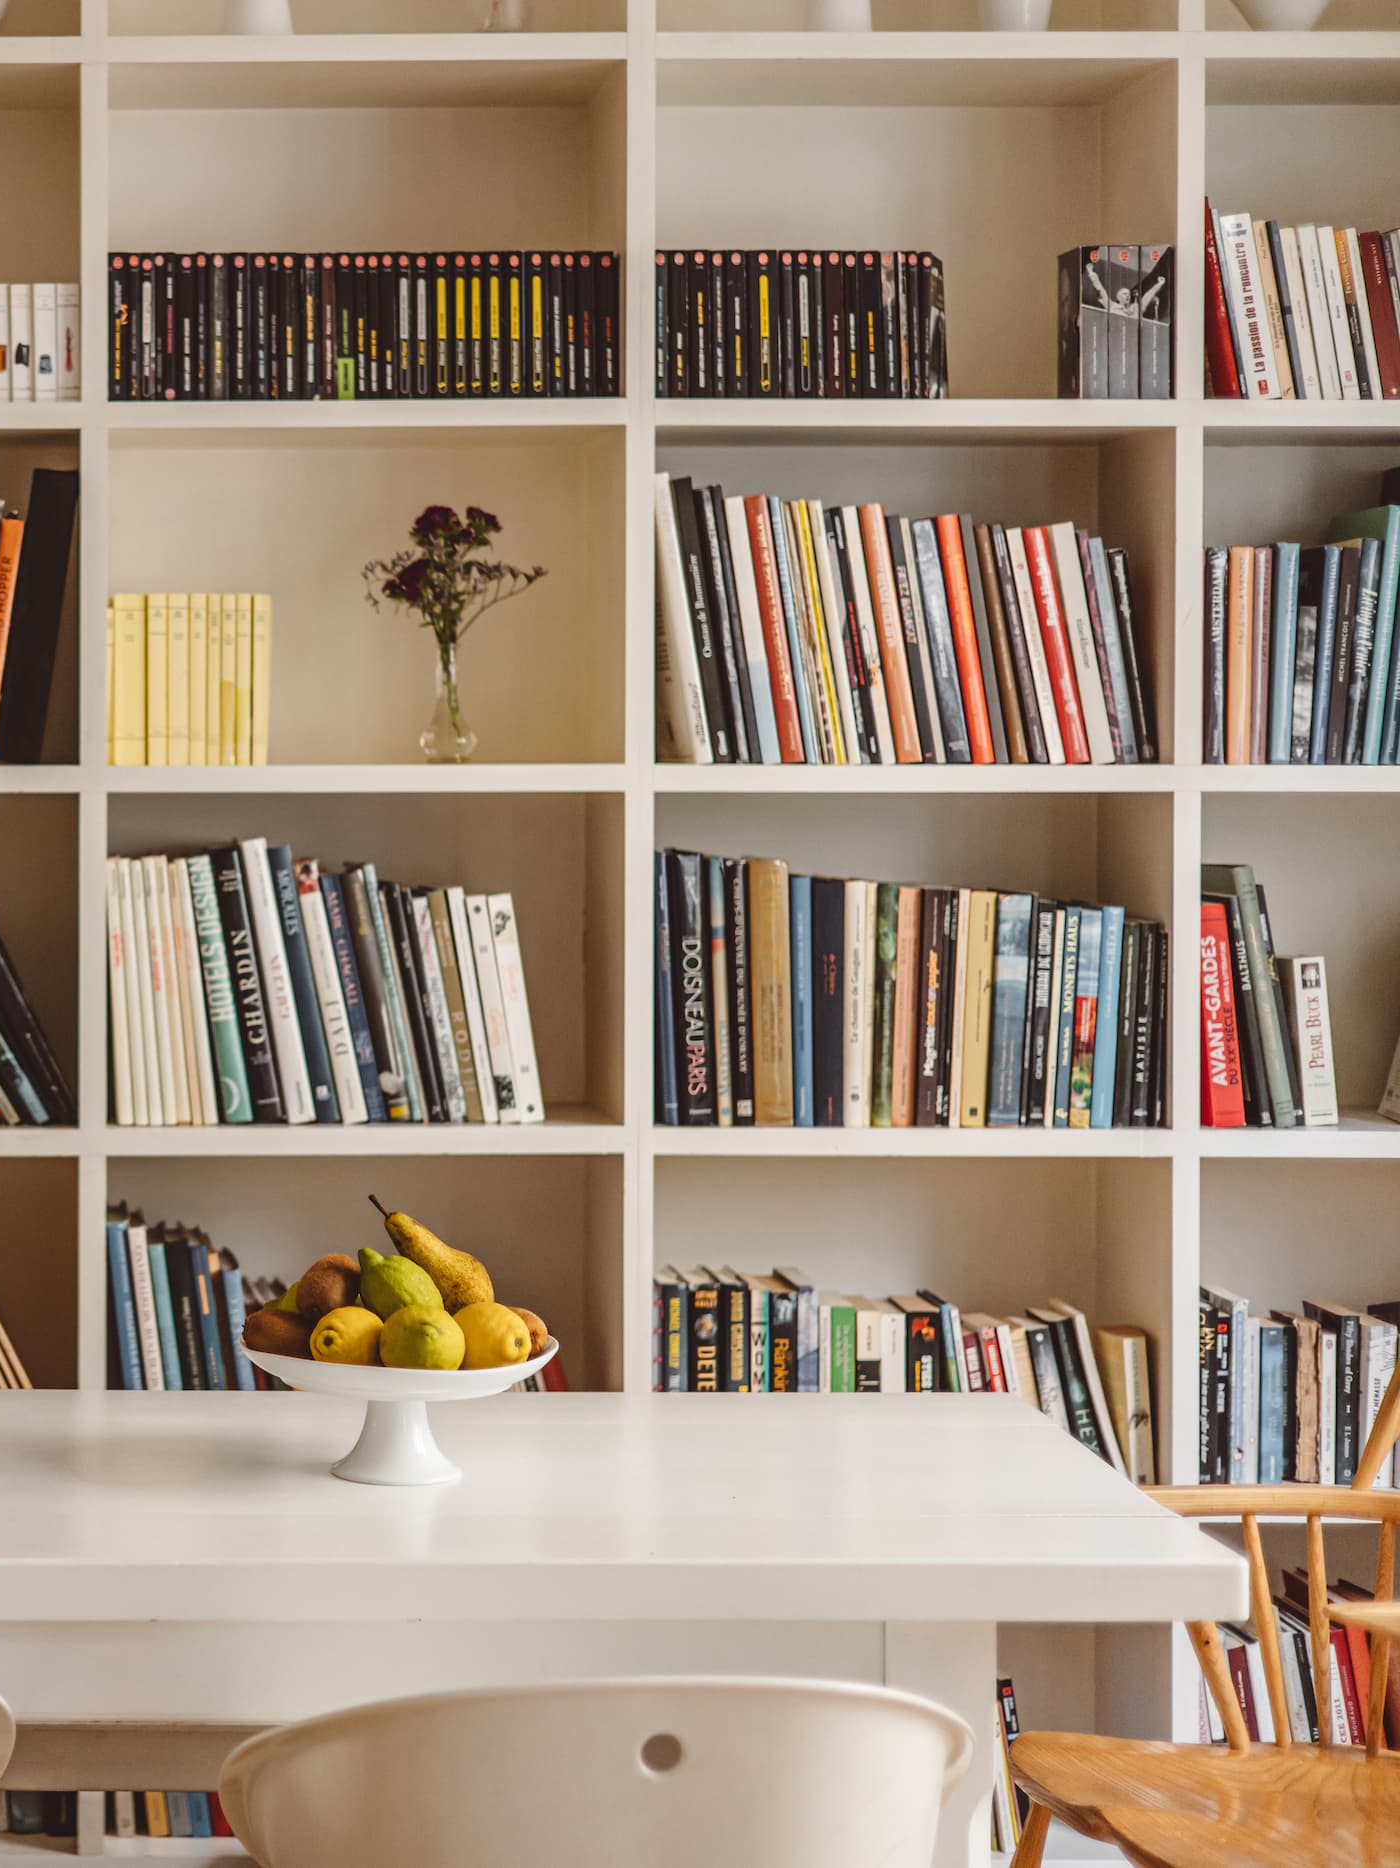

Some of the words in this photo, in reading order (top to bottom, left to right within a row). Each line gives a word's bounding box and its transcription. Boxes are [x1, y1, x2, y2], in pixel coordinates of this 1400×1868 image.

[1233, 241, 1252, 293] rencontre
[1241, 294, 1254, 304] la
[1243, 306, 1256, 319] de
[1246, 320, 1265, 359] passion
[1253, 361, 1266, 373] La
[1211, 567, 1224, 644] AMSTERDAM
[1338, 657, 1347, 682] MICHEL
[187, 855, 221, 936] DESIGN
[1066, 915, 1079, 953] HAUS
[198, 941, 235, 1022] HOTELS
[1062, 954, 1078, 1013] MONETS
[1236, 939, 1252, 991] BALTHUS
[231, 929, 266, 1045] CHARDIN
[682, 937, 706, 1047] DOISNEAU
[1201, 935, 1228, 1087] AVANT-GARDES
[1303, 994, 1321, 1029] BUCK
[1135, 1016, 1146, 1084] MATISSE
[1304, 1031, 1326, 1070] PEARL
[686, 1045, 708, 1096] PARIS
[1227, 1068, 1239, 1086] DU
[1343, 1319, 1355, 1338] Fifty
[1344, 1338, 1355, 1365] Shades
[1344, 1366, 1355, 1375] of
[1343, 1375, 1355, 1394] Grey
